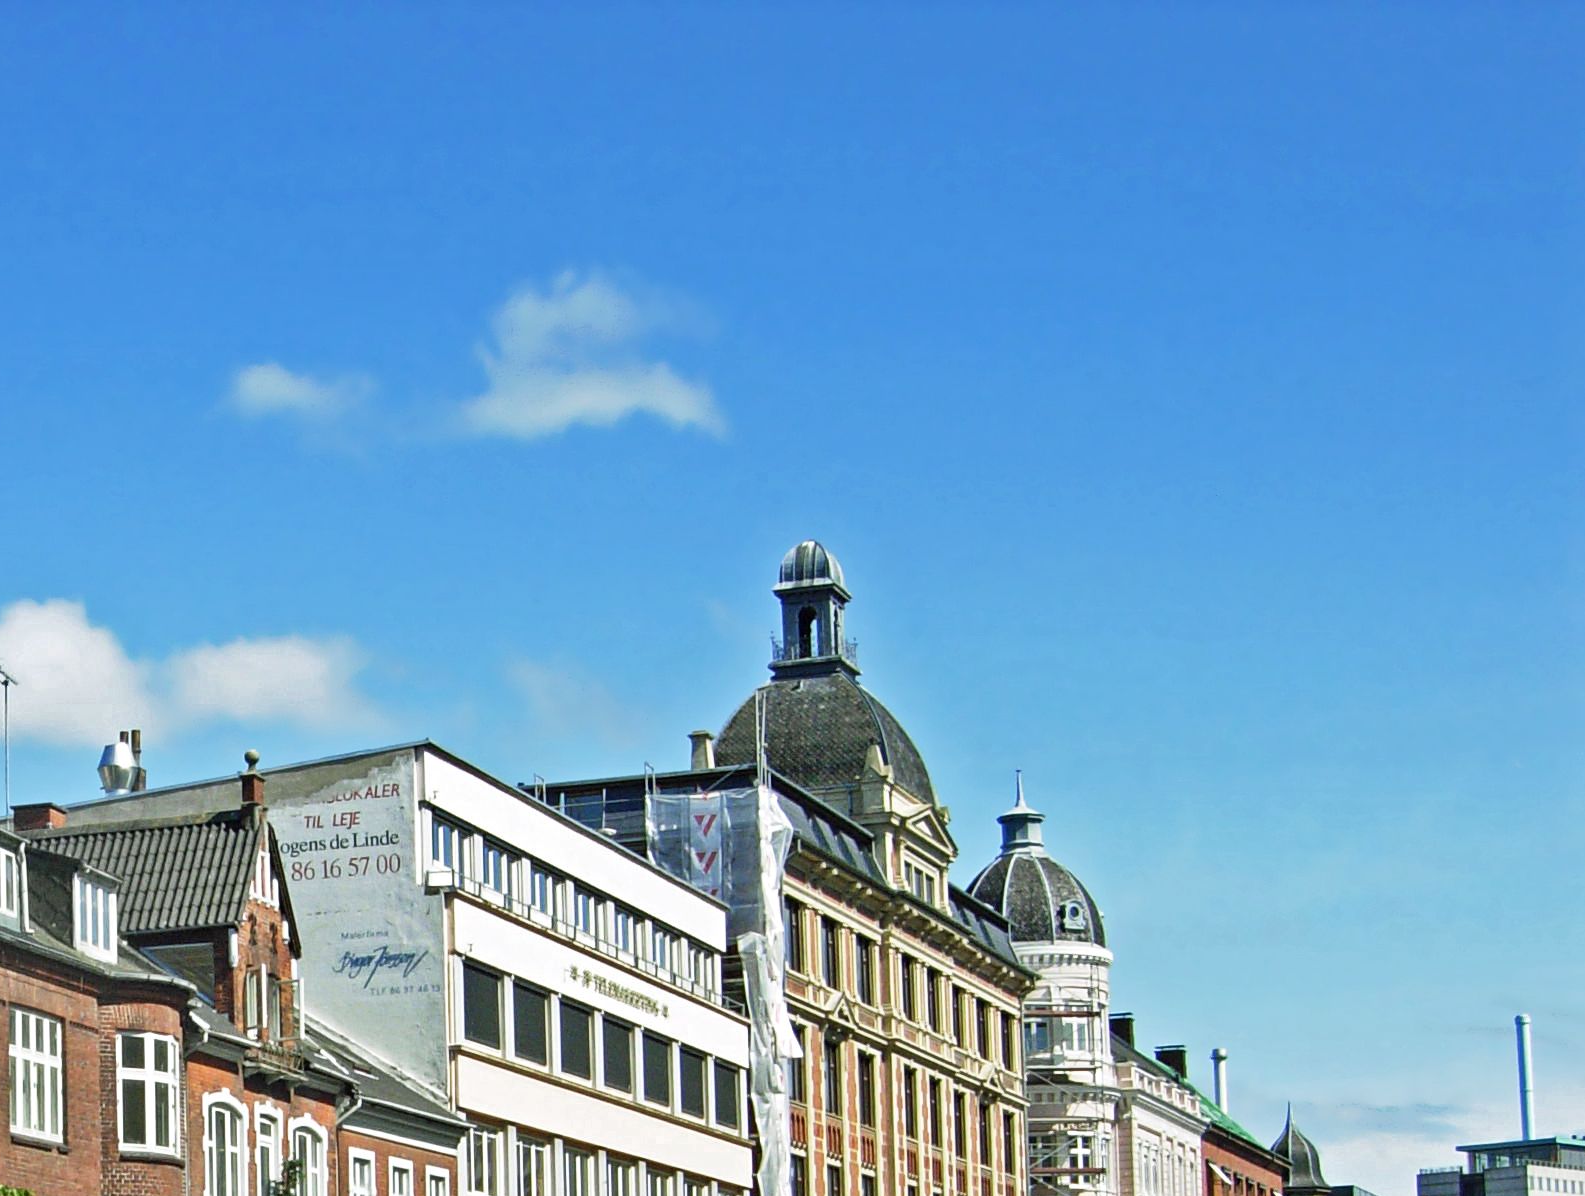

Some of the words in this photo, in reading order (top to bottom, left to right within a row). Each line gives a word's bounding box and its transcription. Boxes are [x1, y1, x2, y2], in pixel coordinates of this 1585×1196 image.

[304, 815, 324, 829] TIL
[332, 811, 361, 829] LEJE
[276, 838, 327, 857] ogens
[330, 834, 349, 849] de
[353, 830, 400, 848] Linde
[291, 860, 315, 881] 86
[322, 858, 342, 879] 16
[348, 856, 370, 877] 57
[376, 853, 401, 874] 00
